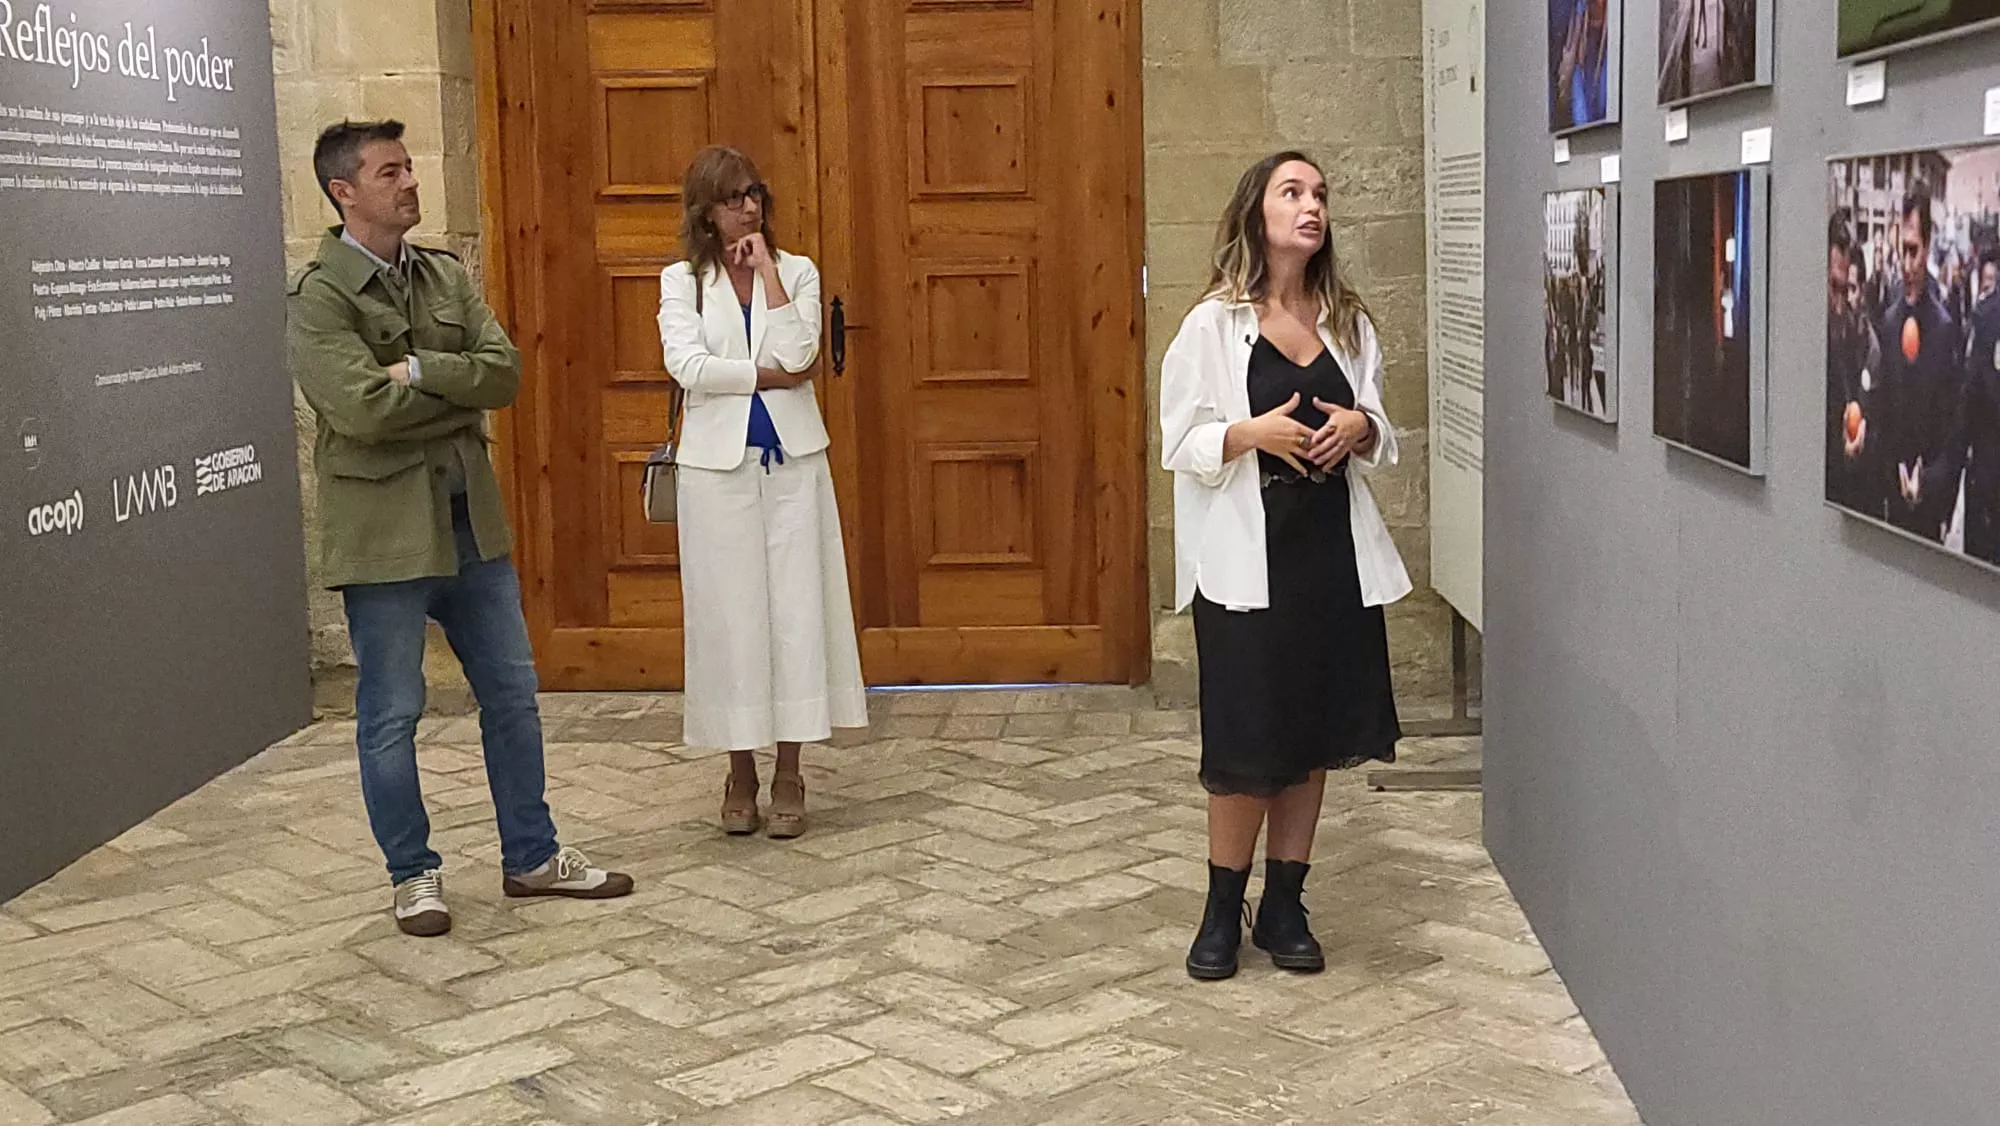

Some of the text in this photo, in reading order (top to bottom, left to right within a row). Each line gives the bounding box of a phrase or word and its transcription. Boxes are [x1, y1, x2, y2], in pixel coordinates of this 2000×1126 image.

[0, 0, 234, 101] Reflejos del poder
[212, 444, 255, 471] GOBIERNO
[213, 471, 226, 492] DE
